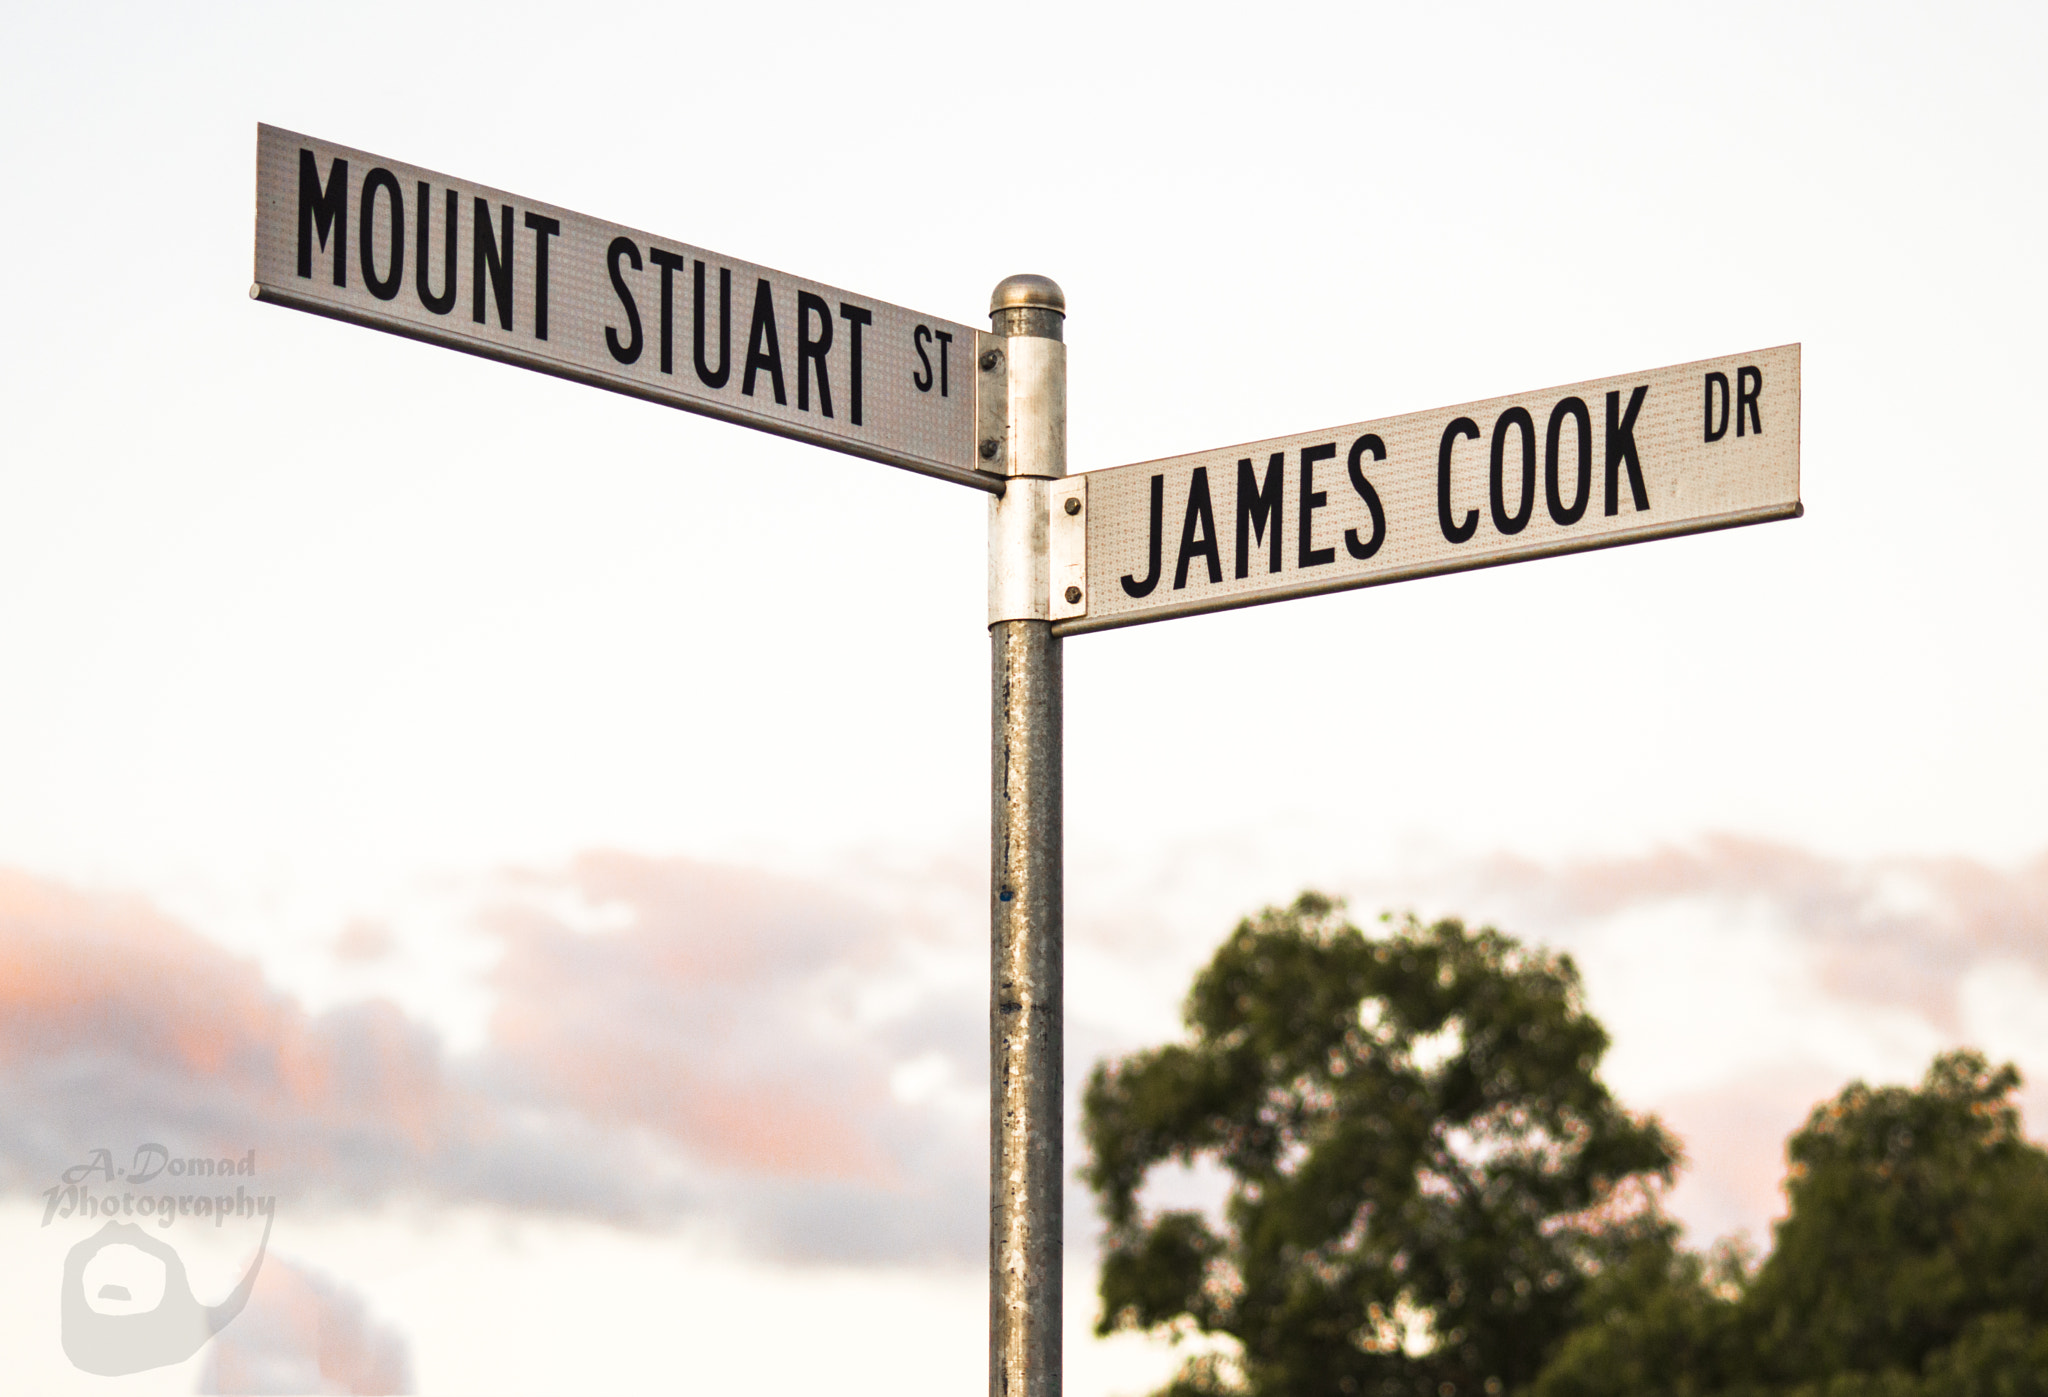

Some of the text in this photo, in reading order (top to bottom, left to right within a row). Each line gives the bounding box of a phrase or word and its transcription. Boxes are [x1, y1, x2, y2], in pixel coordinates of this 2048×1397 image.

[297, 147, 954, 428] MOUNT STUART ST
[1120, 365, 1764, 600] JAMES COOK DR
